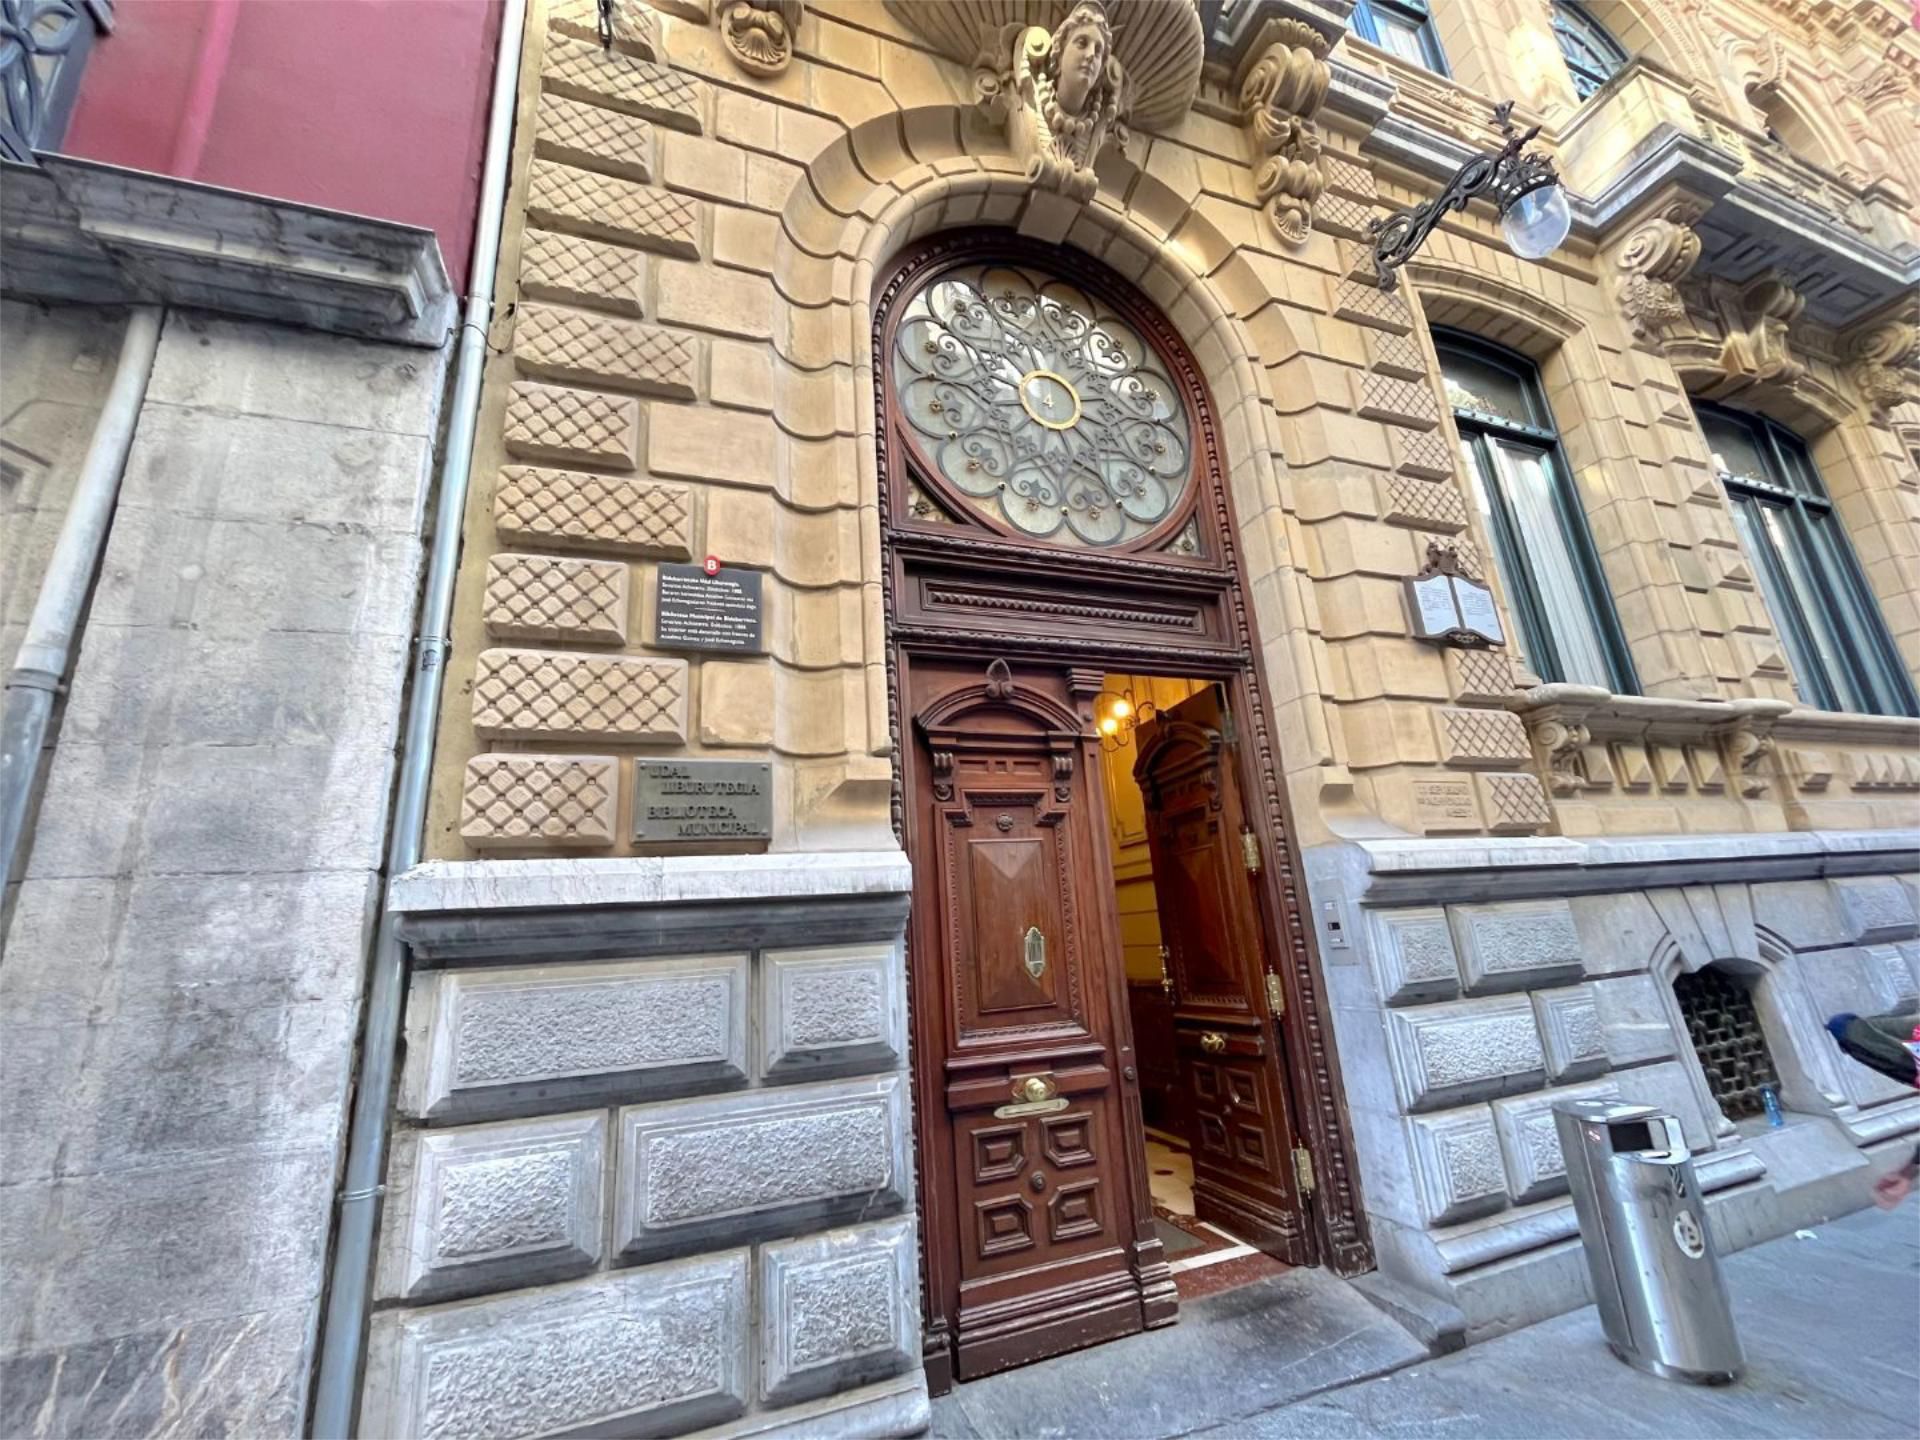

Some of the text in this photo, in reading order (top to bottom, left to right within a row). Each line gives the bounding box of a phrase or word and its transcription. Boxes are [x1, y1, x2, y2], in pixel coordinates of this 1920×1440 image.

[1042, 392, 1055, 408] 4
[707, 560, 717, 570] B
[649, 765, 691, 779] UDAL
[661, 782, 760, 796] LIBURUTEGIA
[647, 806, 737, 820] BIBLIOTECA
[678, 823, 760, 837] MUNICIPAL
